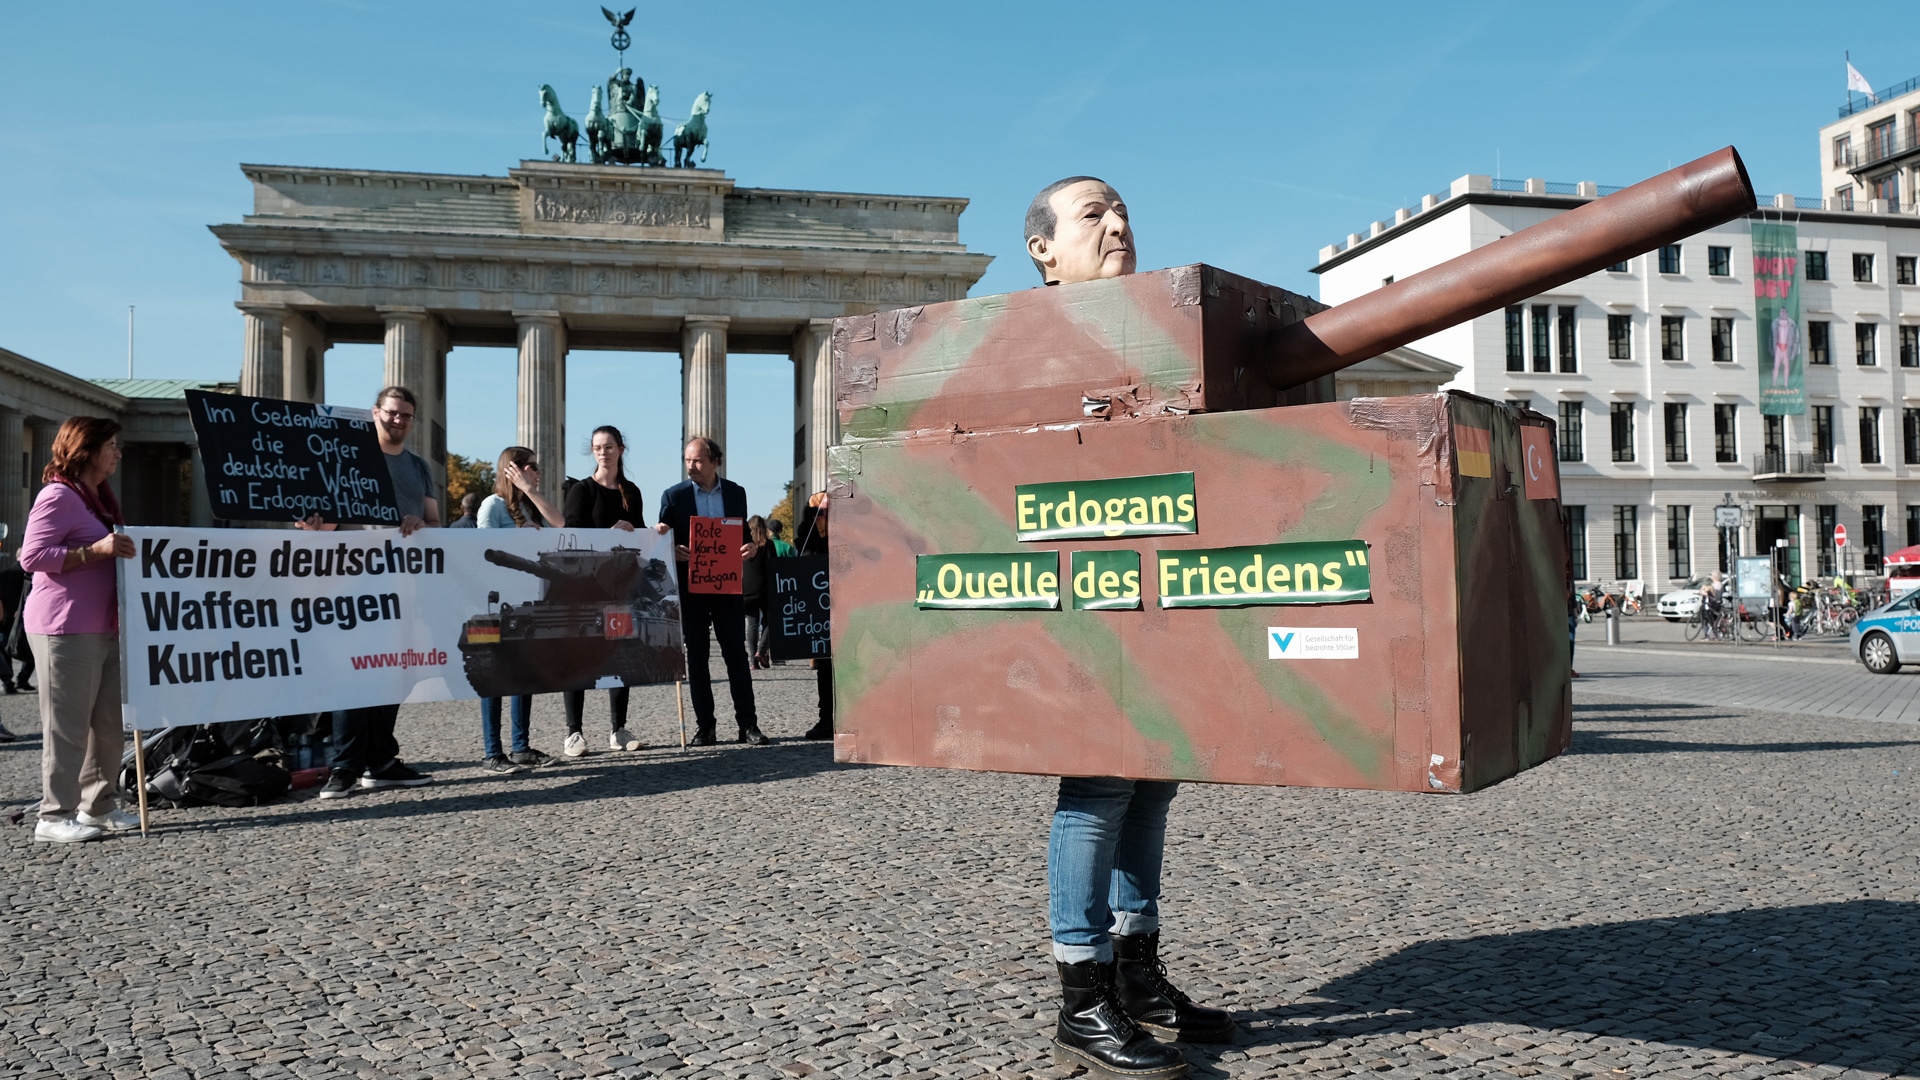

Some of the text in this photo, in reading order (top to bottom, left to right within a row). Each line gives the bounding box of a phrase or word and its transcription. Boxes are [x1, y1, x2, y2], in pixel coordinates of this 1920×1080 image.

[202, 398, 236, 424] Im
[251, 402, 338, 430] Gedenken
[349, 419, 370, 432] an
[252, 431, 359, 463] die Opfer
[222, 452, 379, 499] deutscher Waffen
[218, 482, 399, 522] in Erdogans Händen
[1017, 490, 1195, 538] Erdogans
[694, 522, 722, 538] Rote
[141, 538, 445, 579] Keine deutschen
[694, 539, 727, 555] Karte
[694, 554, 719, 570] für
[691, 569, 738, 590] Erdogan
[775, 571, 830, 594] Im G
[1073, 559, 1140, 600] des
[141, 589, 401, 633] Waffen gegen
[782, 595, 806, 616] die
[812, 638, 826, 654] in
[1305, 635, 1344, 643] Gesellschaft
[148, 638, 303, 686] Kurden!
[350, 647, 448, 671] www.gfbv.de
